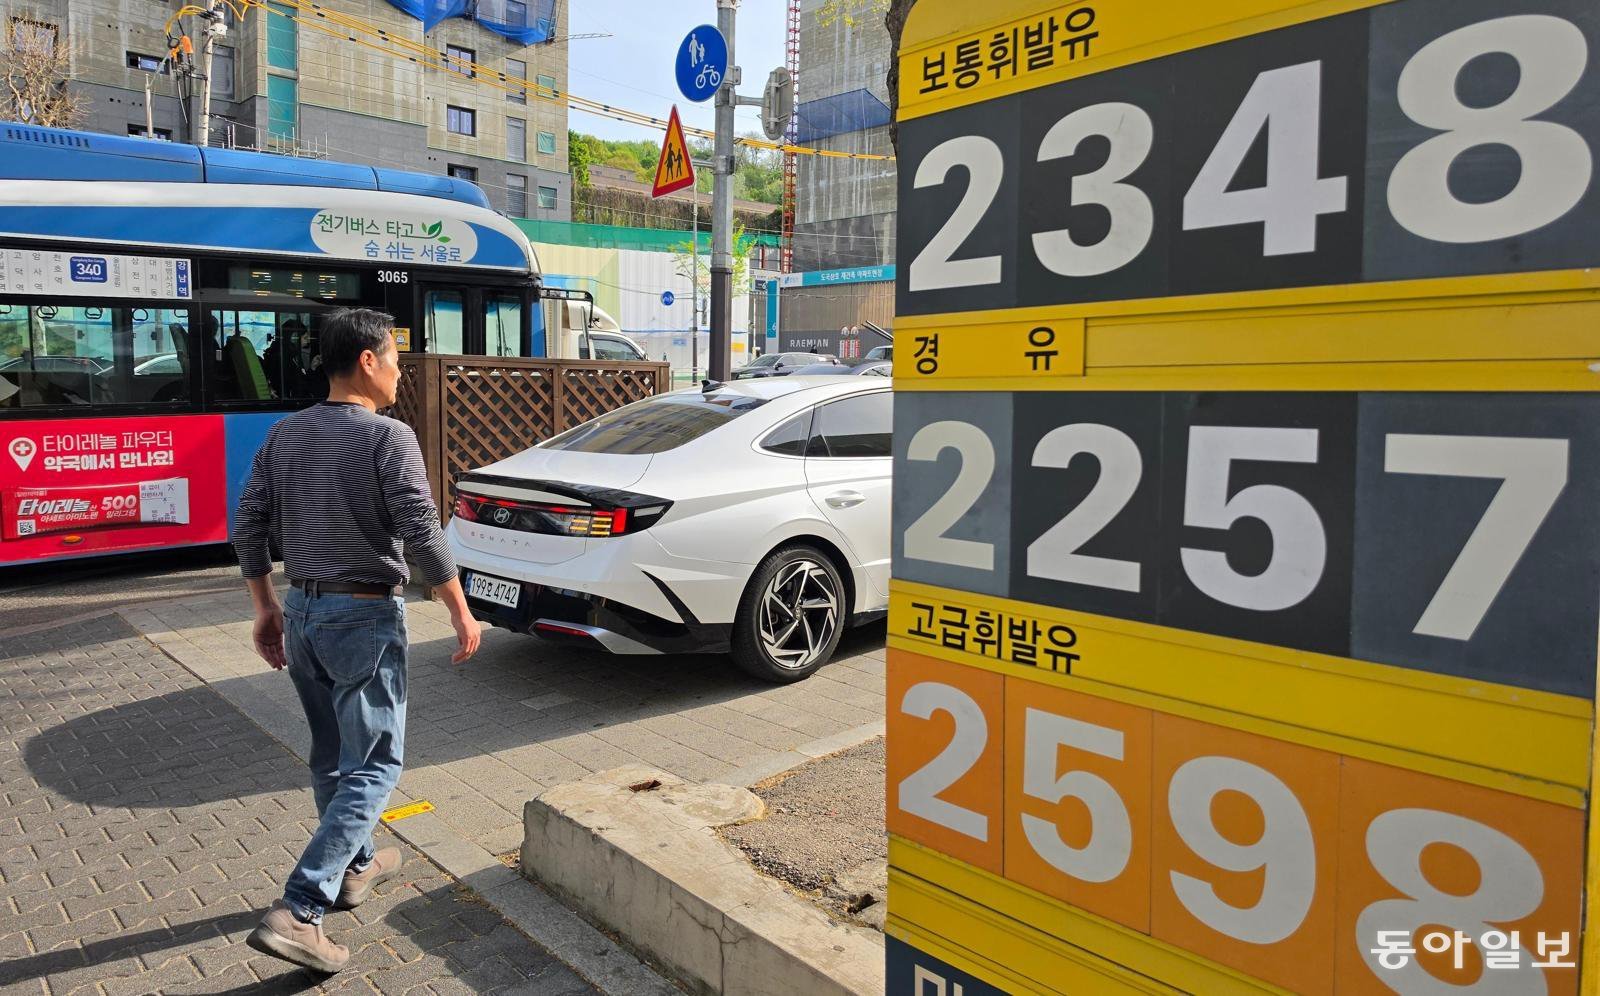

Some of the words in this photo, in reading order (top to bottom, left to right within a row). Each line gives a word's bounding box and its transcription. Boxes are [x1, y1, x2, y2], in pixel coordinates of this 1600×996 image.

[919, 7, 1100, 95] 보통휘발유
[908, 14, 1593, 291] 2348
[317, 214, 381, 236] 전기버스
[386, 220, 415, 239] 타고
[364, 239, 380, 258] 숨
[385, 241, 415, 261] 쉬는
[420, 245, 462, 263] 서울로
[76, 263, 101, 276] 340
[178, 261, 187, 296] 강남역
[378, 270, 409, 284] 3065
[43, 433, 118, 452] 타이레놀
[123, 430, 173, 449] 파우더
[44, 454, 115, 472] 약국에서
[119, 450, 174, 469] 만나요!
[101, 494, 137, 511] 500
[904, 420, 1570, 641] 2257
[908, 602, 1080, 675] 고급휘발유
[898, 681, 1550, 996] 2598
